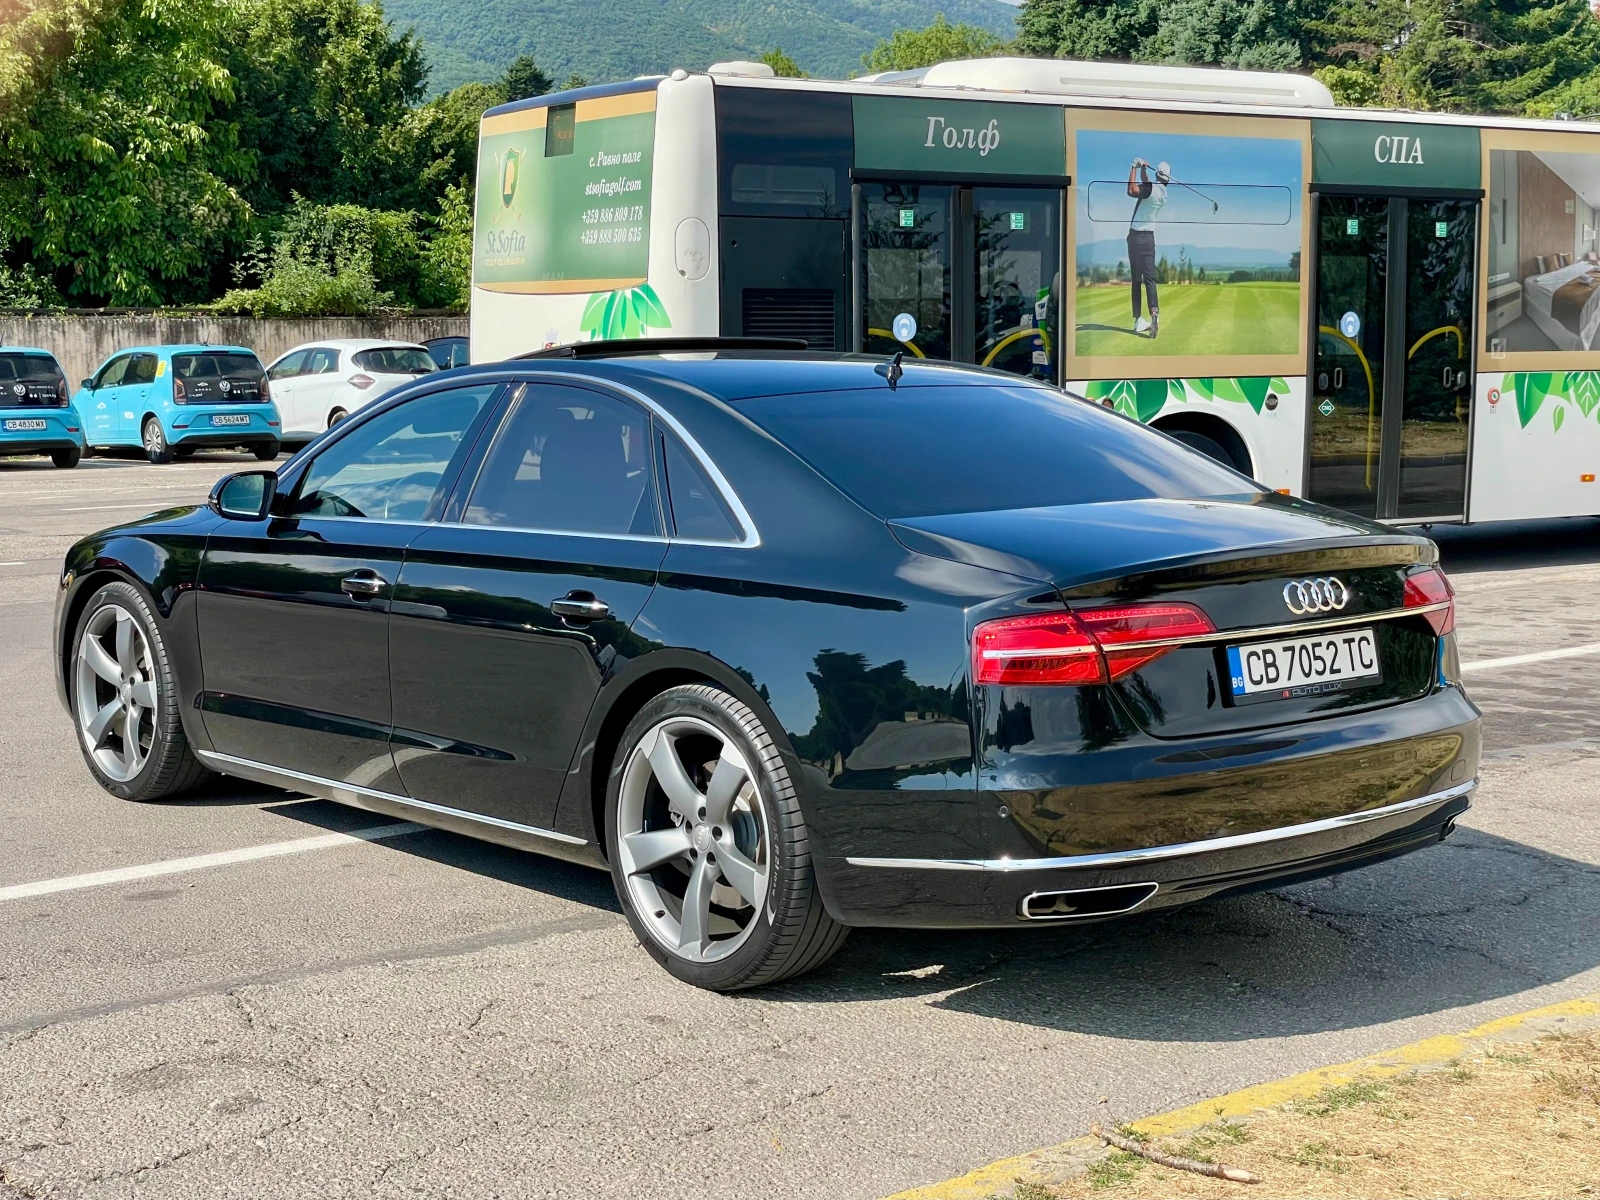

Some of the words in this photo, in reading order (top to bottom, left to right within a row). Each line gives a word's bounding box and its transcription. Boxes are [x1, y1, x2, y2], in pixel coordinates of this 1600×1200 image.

[924, 116, 1000, 156] Голф
[1374, 135, 1424, 164] СПА
[597, 151, 621, 167] Равно
[622, 151, 642, 164] поле
[585, 177, 642, 197] stsofiagolf.com
[582, 208, 599, 224] +359
[599, 207, 614, 223] 886
[614, 206, 628, 222] 809
[629, 205, 644, 221] 178
[581, 229, 598, 244] +359
[598, 228, 613, 244] 888
[613, 228, 627, 243] 500
[628, 227, 643, 242] 635
[7, 421, 18, 429] CB
[213, 416, 224, 425] CB
[1232, 677, 1244, 688] BG
[1246, 648, 1281, 686] CB
[1282, 640, 1342, 682] 7052
[1342, 635, 1374, 672] TC
[1292, 685, 1321, 697] AUTO
[1321, 682, 1343, 692] LUX
